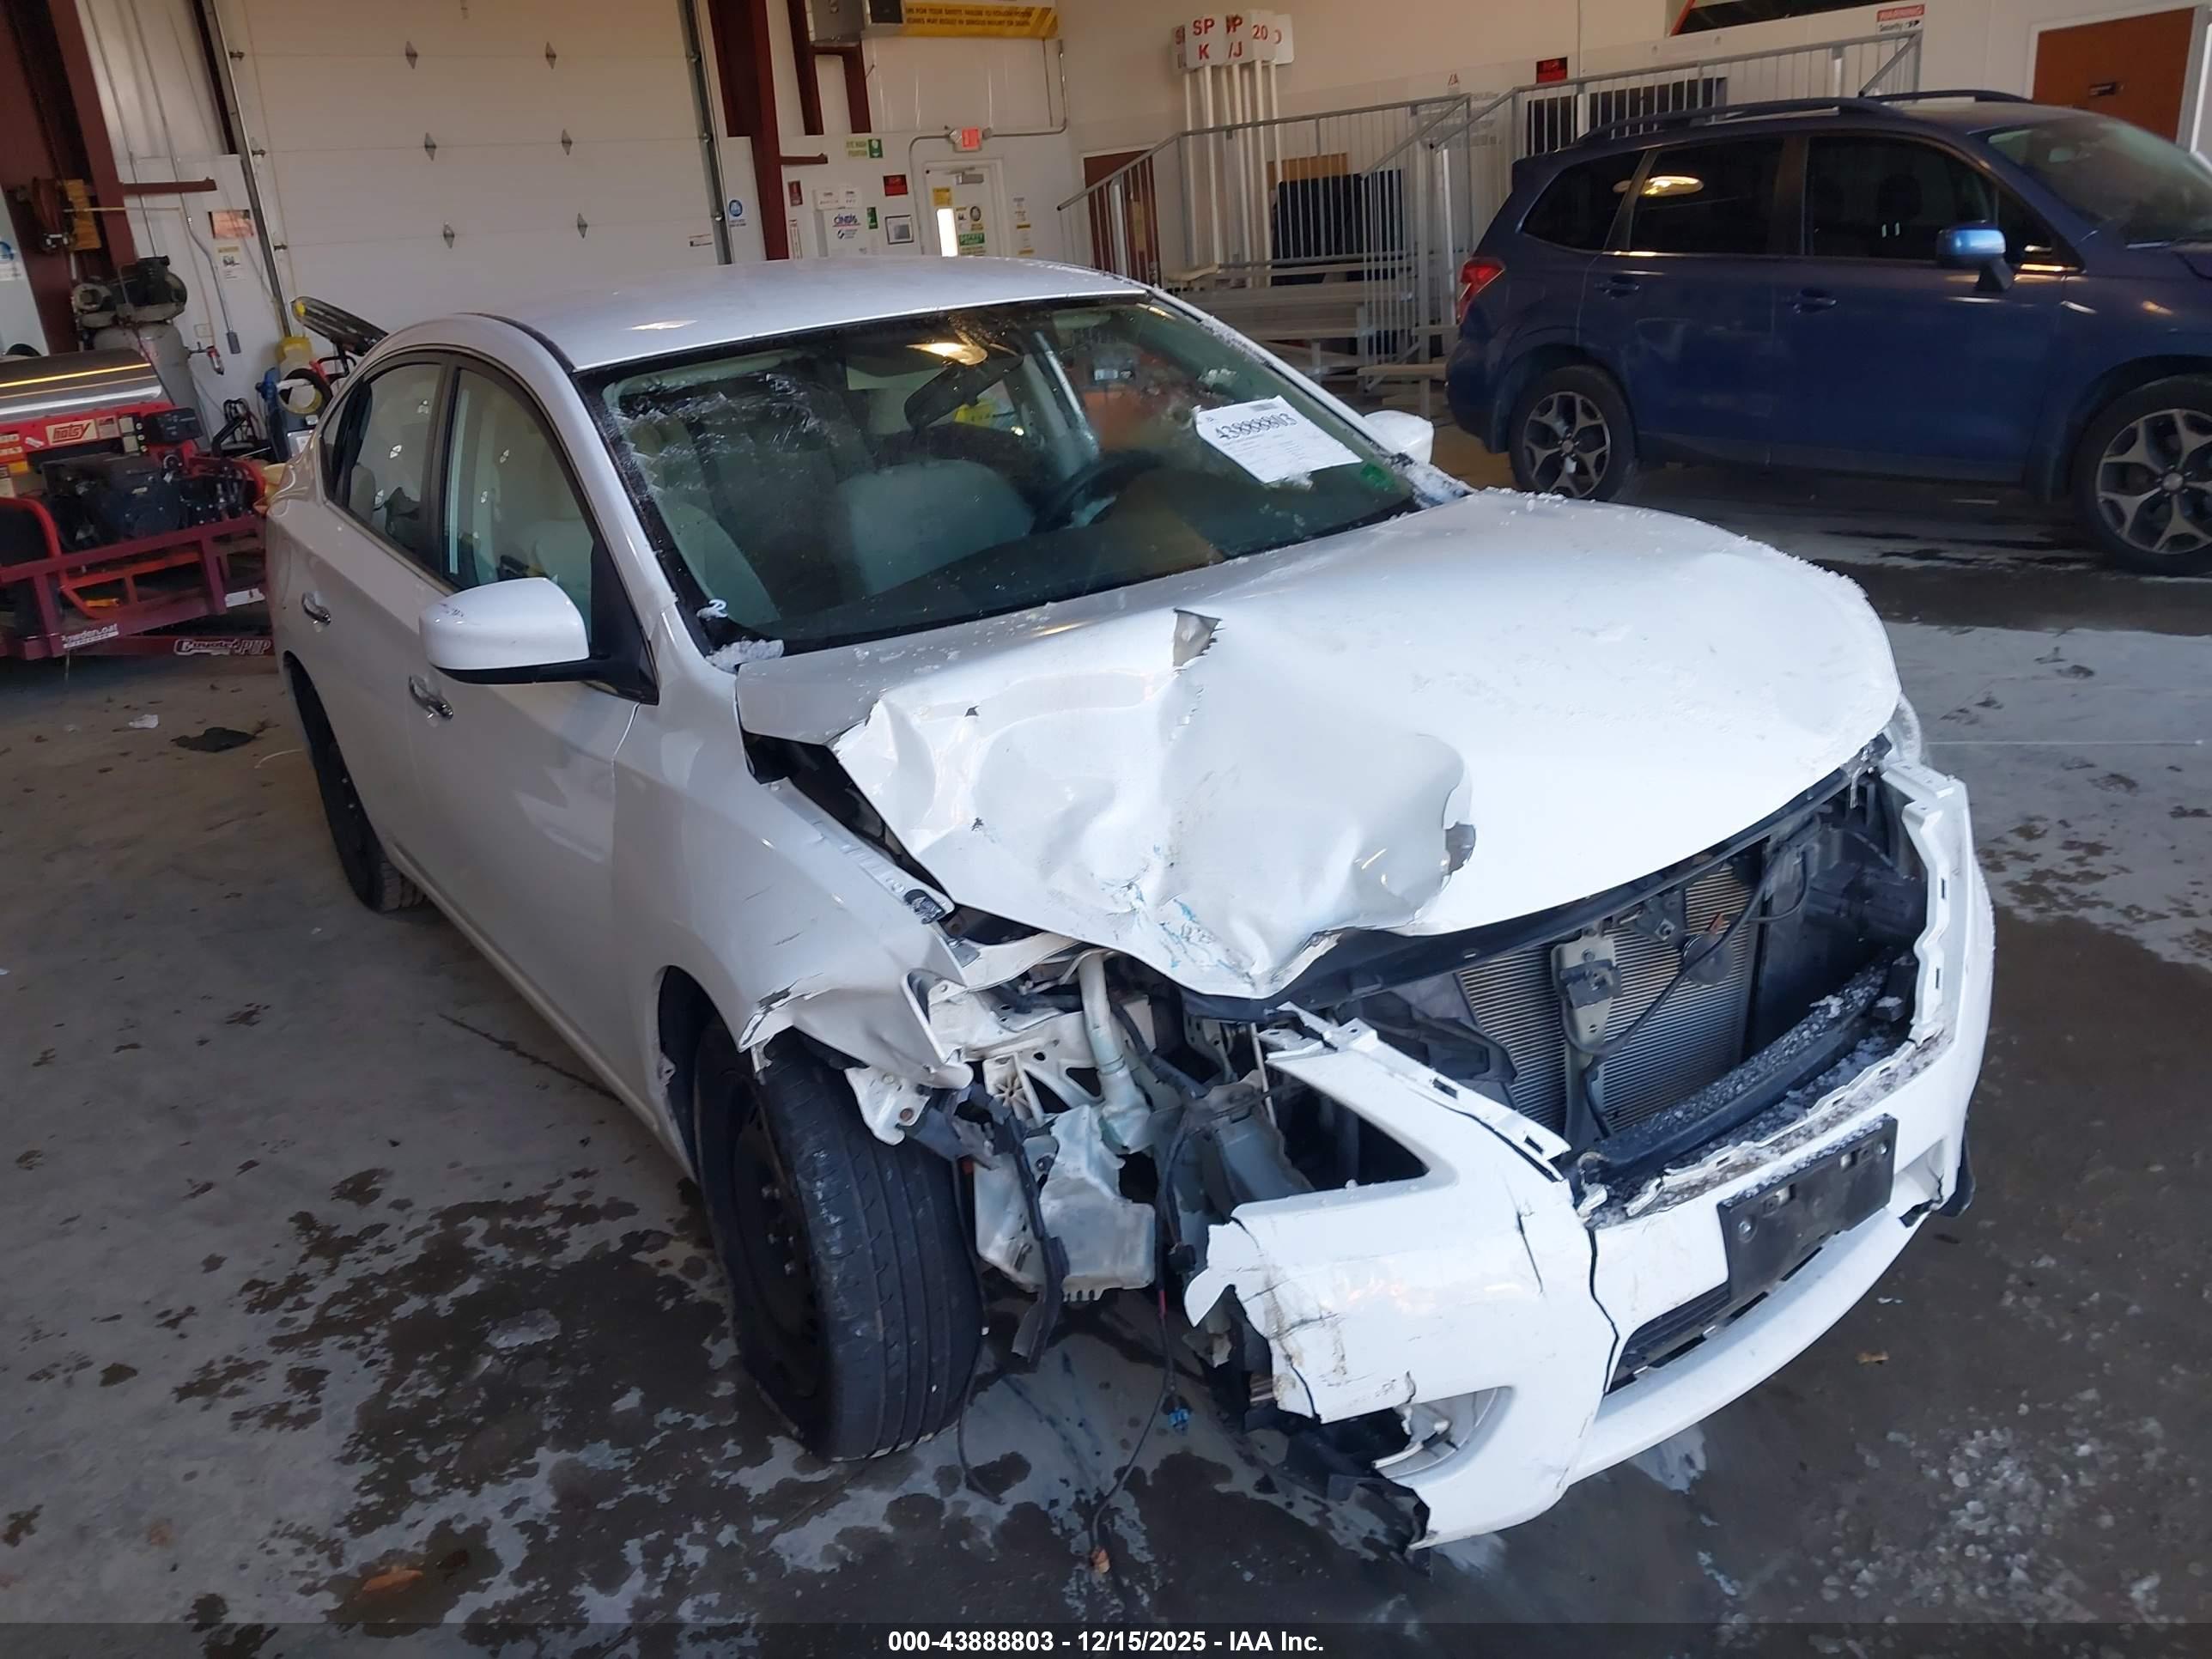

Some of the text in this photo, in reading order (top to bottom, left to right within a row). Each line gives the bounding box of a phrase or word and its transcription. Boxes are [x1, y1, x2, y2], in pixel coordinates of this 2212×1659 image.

[1193, 18, 1215, 36] SP
[1252, 24, 1268, 40] 20
[1198, 43, 1210, 60] K
[1215, 412, 1297, 440] 43888803
